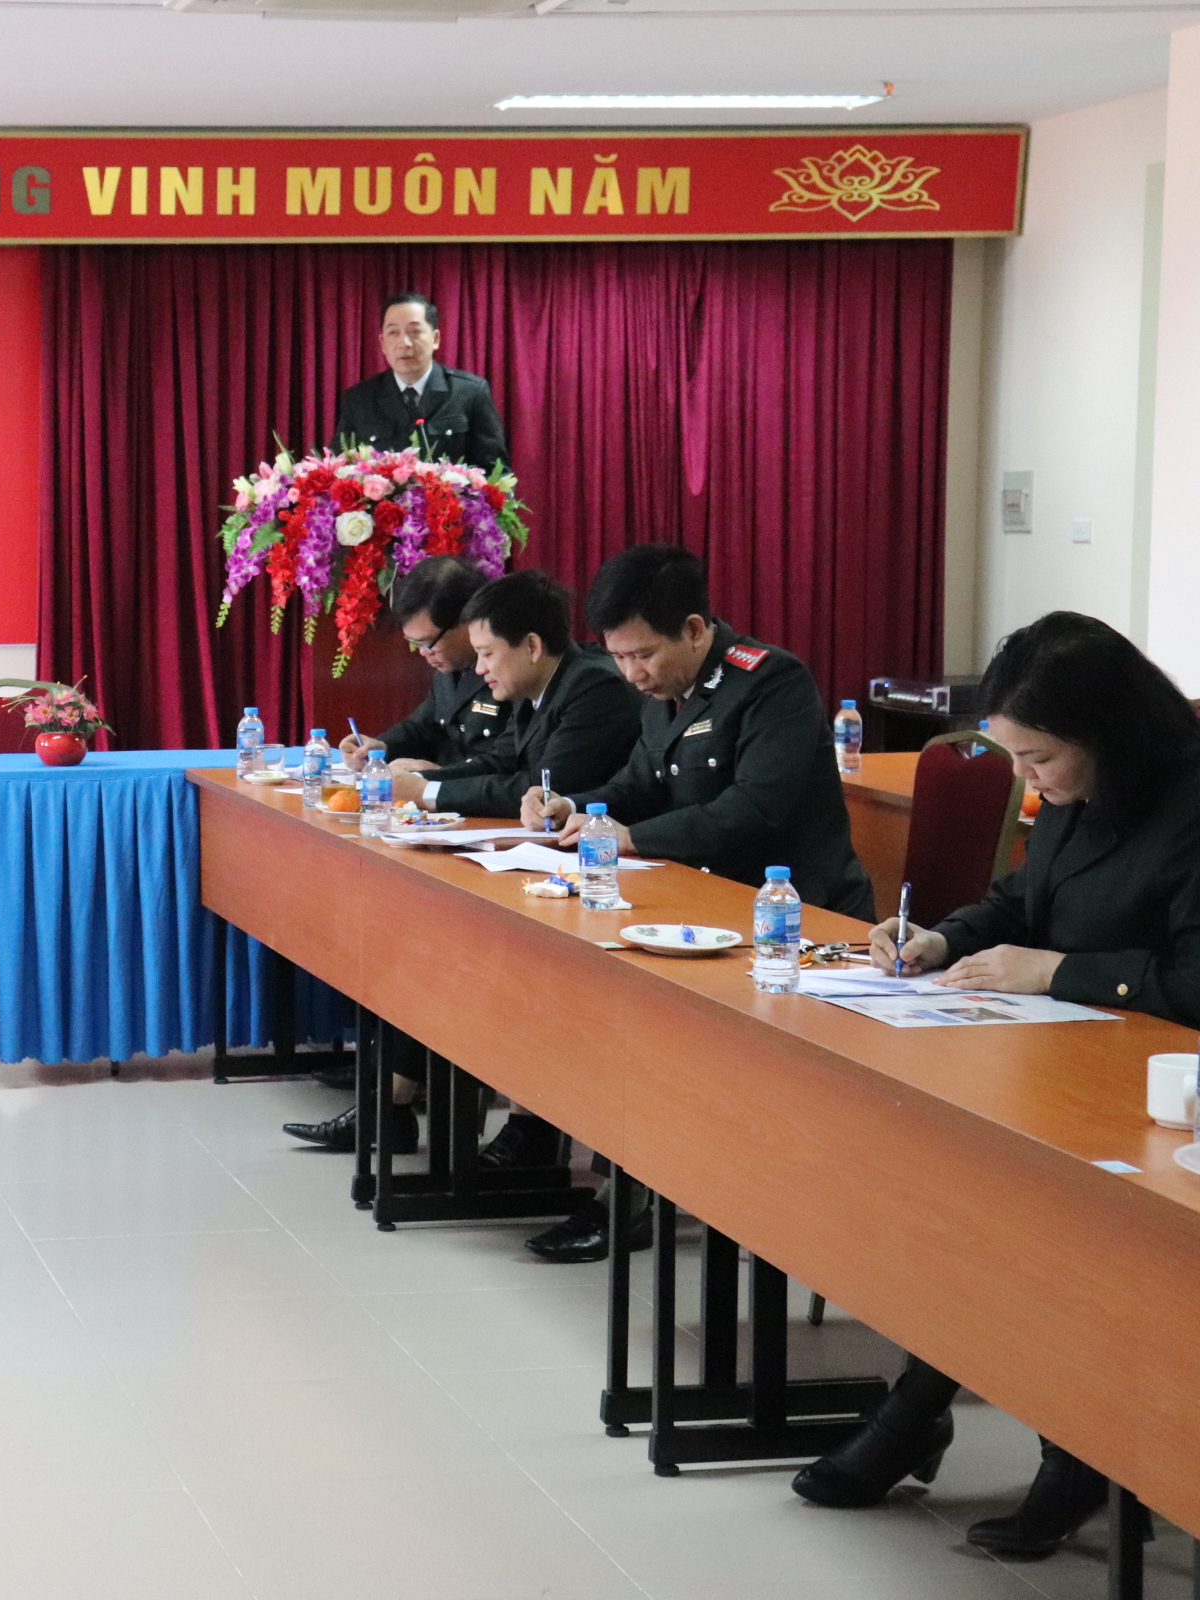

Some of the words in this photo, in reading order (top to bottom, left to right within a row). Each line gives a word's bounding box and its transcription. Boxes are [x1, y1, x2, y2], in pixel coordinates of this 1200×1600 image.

[81, 165, 256, 217] VINH
[284, 150, 499, 217] MUÔN
[528, 152, 693, 216] NĂM
